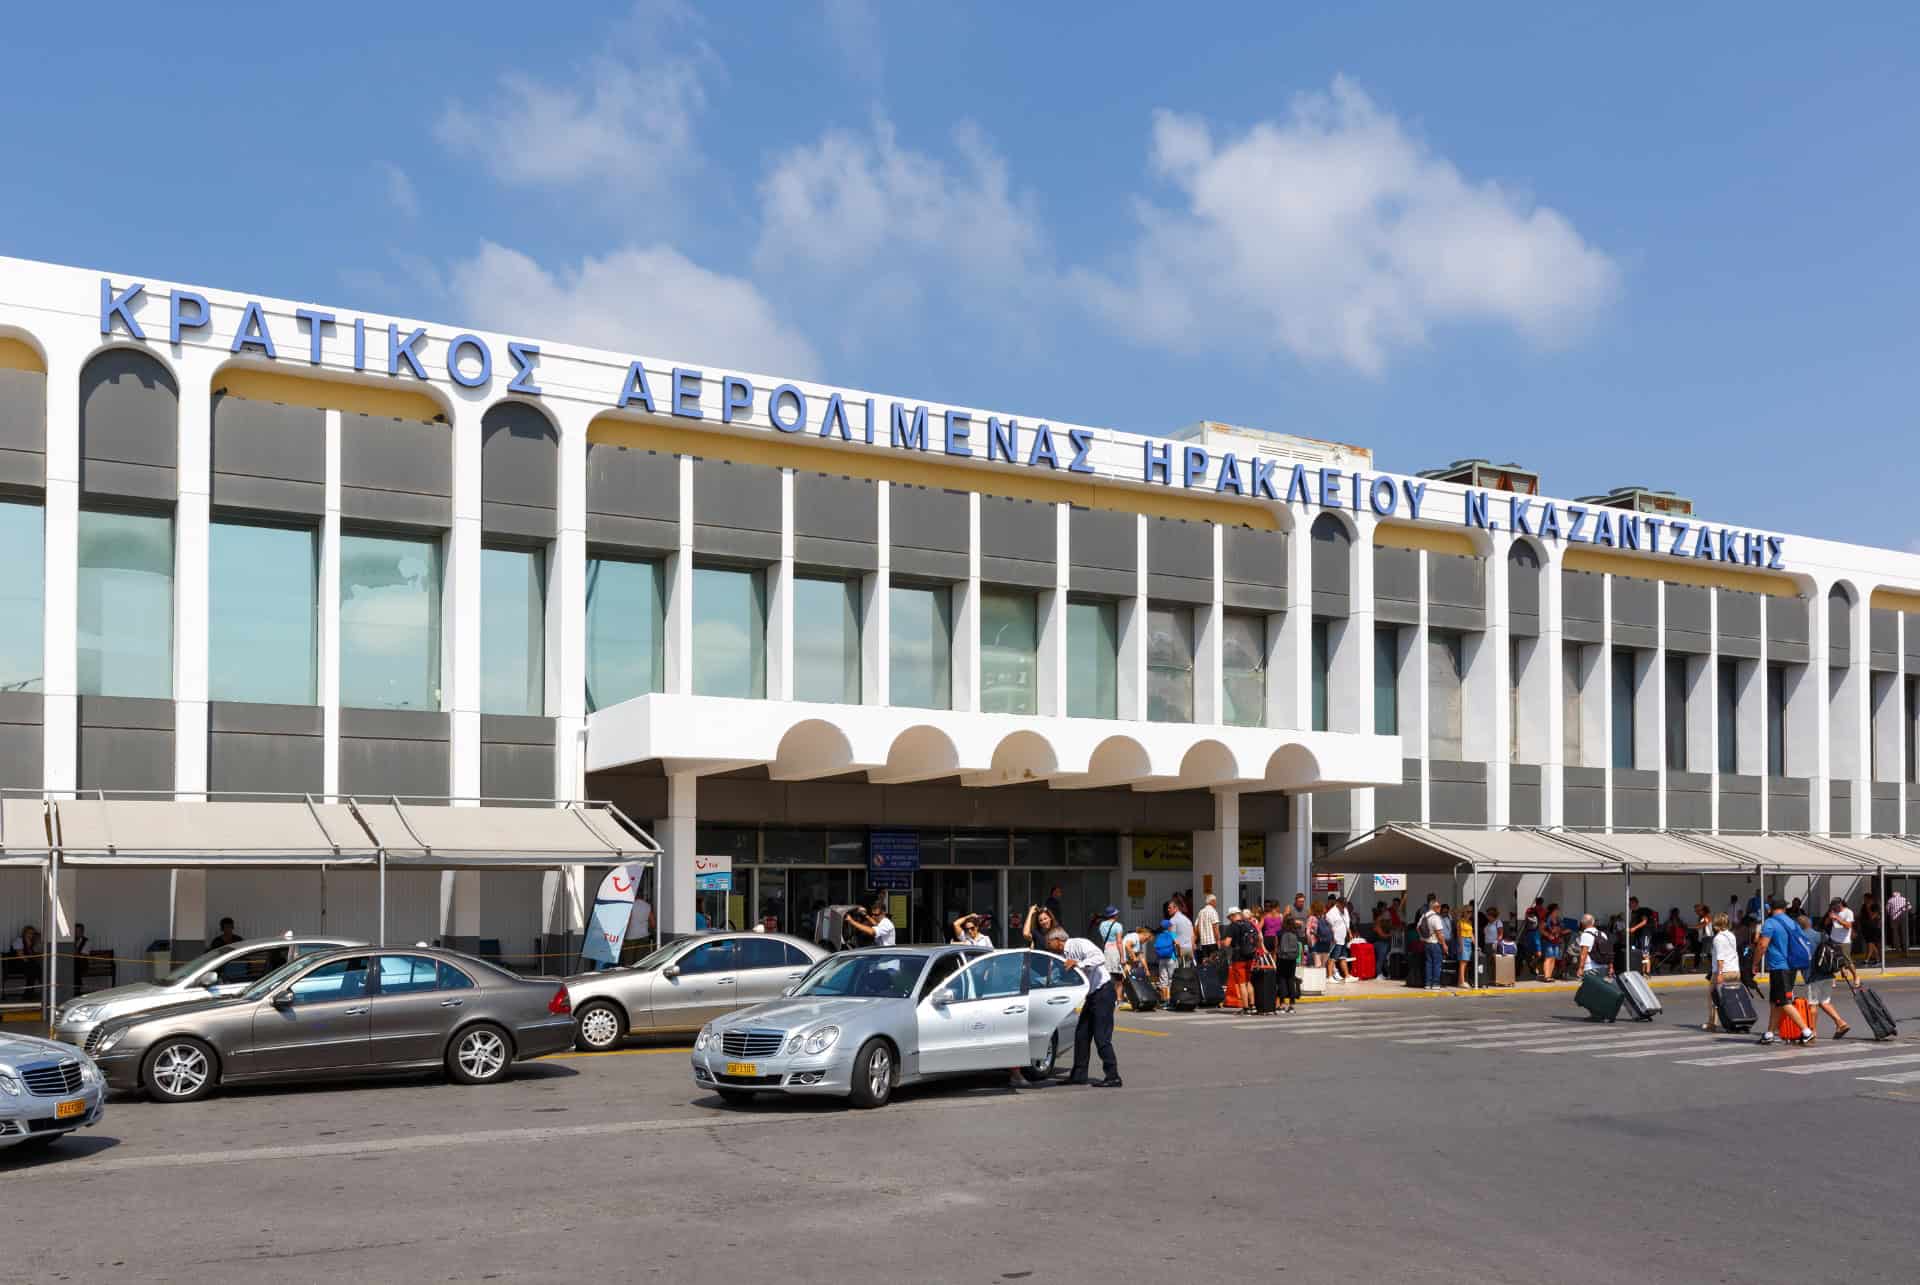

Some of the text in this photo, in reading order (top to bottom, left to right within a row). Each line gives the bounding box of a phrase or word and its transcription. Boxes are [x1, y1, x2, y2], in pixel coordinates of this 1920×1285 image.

[101, 278, 543, 395] ΚΡΑΤΙΚΟΣ
[617, 361, 1096, 474] ΑΕΡΟΛΙΜΕΝΑΣ
[1144, 440, 1427, 519] ΗΡΑΚΛΕΙΟΥ
[603, 932, 619, 943] TUI
